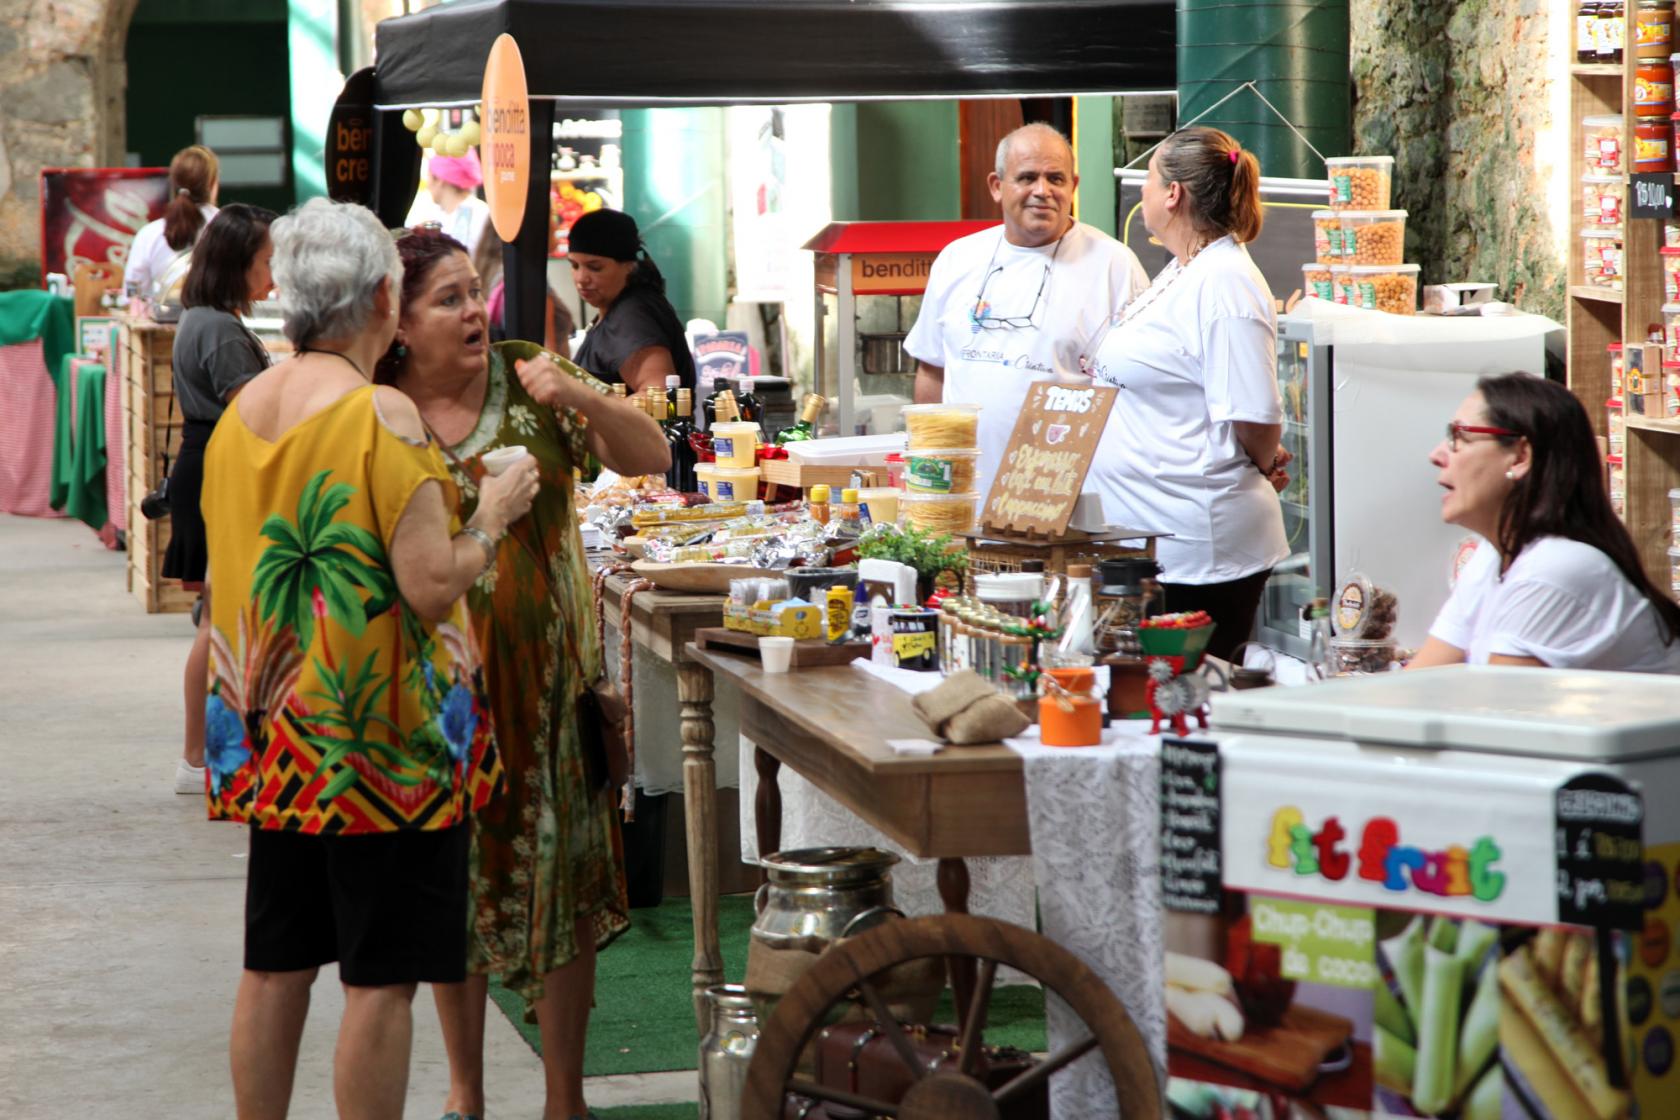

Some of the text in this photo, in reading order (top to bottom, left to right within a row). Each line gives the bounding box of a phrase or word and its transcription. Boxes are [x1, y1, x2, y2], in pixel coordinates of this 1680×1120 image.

[487, 143, 515, 173] poca
[1044, 386, 1095, 413] TEMOS
[1267, 805, 1350, 881] fit
[1358, 816, 1507, 902] fruit
[1253, 903, 1374, 948] Chup-Chup
